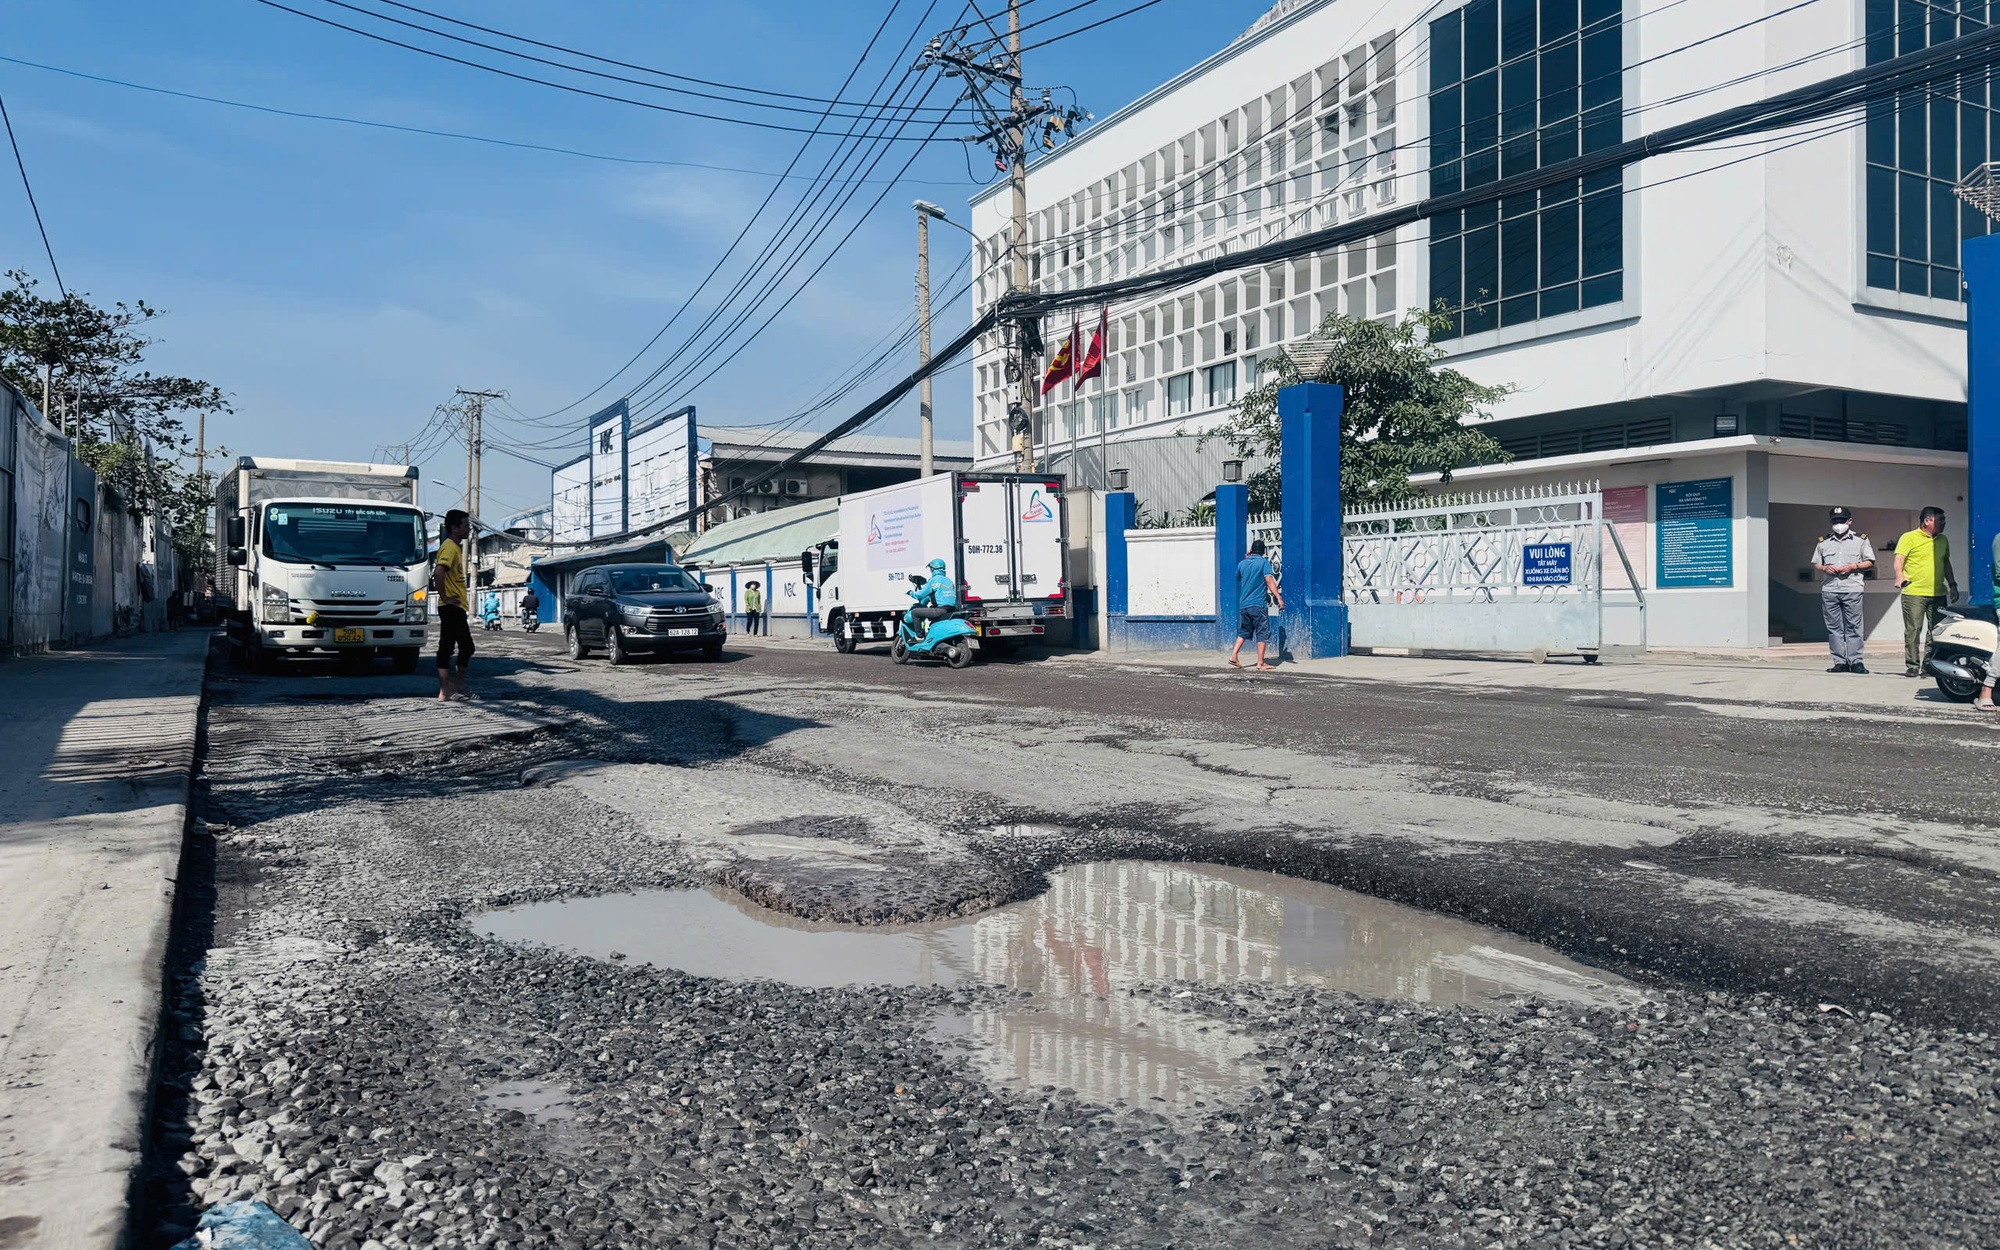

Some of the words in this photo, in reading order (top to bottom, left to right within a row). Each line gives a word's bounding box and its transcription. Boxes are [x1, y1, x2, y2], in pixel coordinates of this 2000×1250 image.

[968, 544, 1003, 554] 50H-772.38
[1529, 549, 1543, 559] VUI
[1545, 546, 1565, 558] LÒNG
[1562, 566, 1569, 574] BỘ
[331, 590, 366, 598] ISUZU
